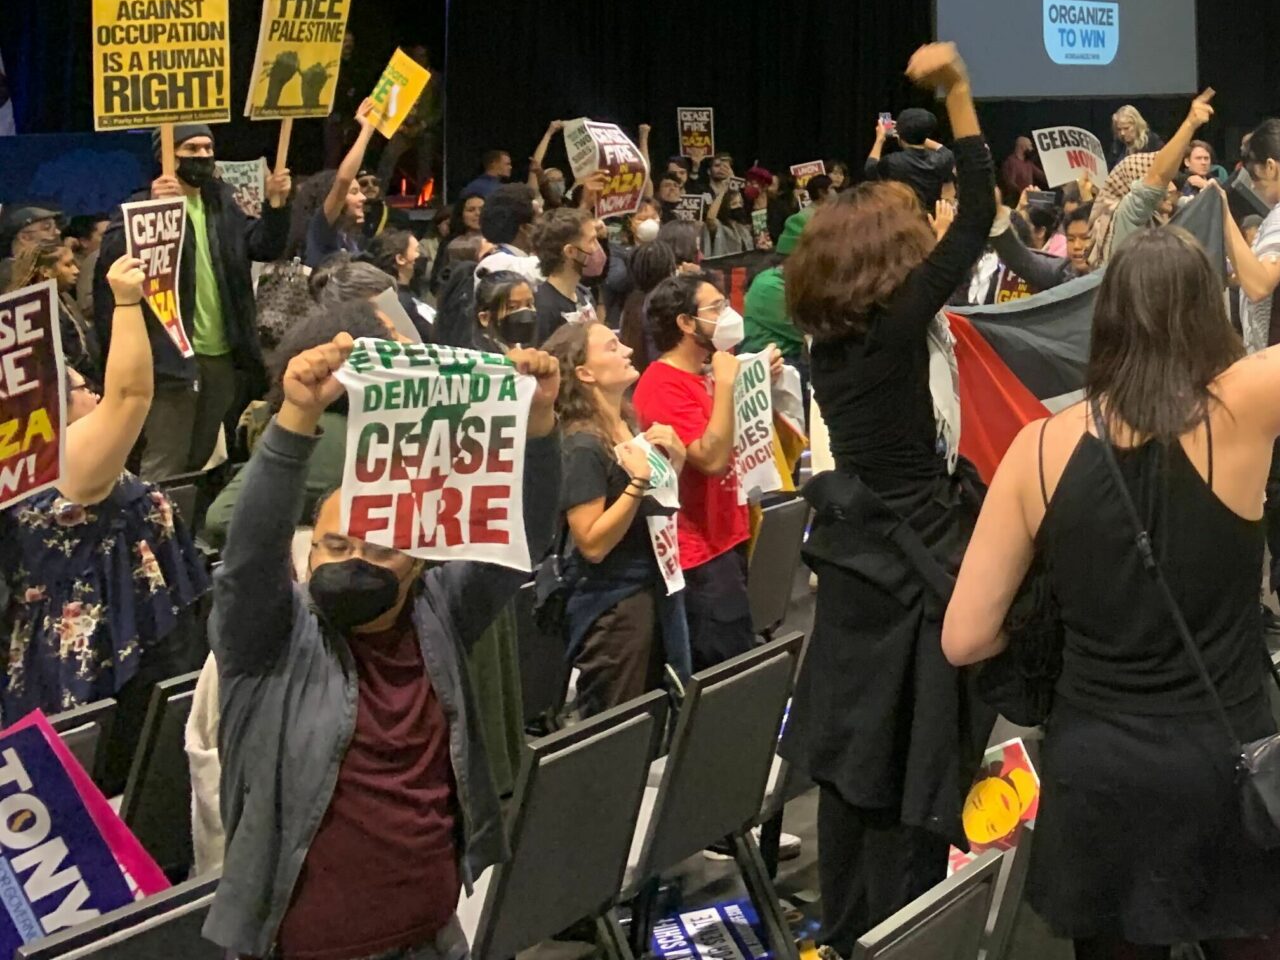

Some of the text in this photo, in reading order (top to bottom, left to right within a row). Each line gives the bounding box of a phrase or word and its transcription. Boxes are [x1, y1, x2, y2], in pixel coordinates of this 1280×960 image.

[117, 0, 204, 20] AGAINST
[1049, 4, 1114, 26] ORGANIZE
[97, 21, 224, 45] OCCUPATION
[268, 20, 345, 43] PALESTINE
[1058, 28, 1105, 48] TO WIN
[103, 48, 224, 72] IS A HUMAN
[104, 70, 224, 113] RIGHT!
[681, 111, 710, 121] CEASE
[683, 122, 708, 132] FIRE
[603, 144, 639, 165] FIRE
[132, 209, 181, 245] CEASE
[139, 243, 175, 277] FIRE
[743, 360, 766, 393] NO
[363, 374, 517, 412] DEMAND A
[355, 415, 517, 482] CEASE
[348, 485, 511, 550] FIRE
[0, 747, 101, 934] TONY
